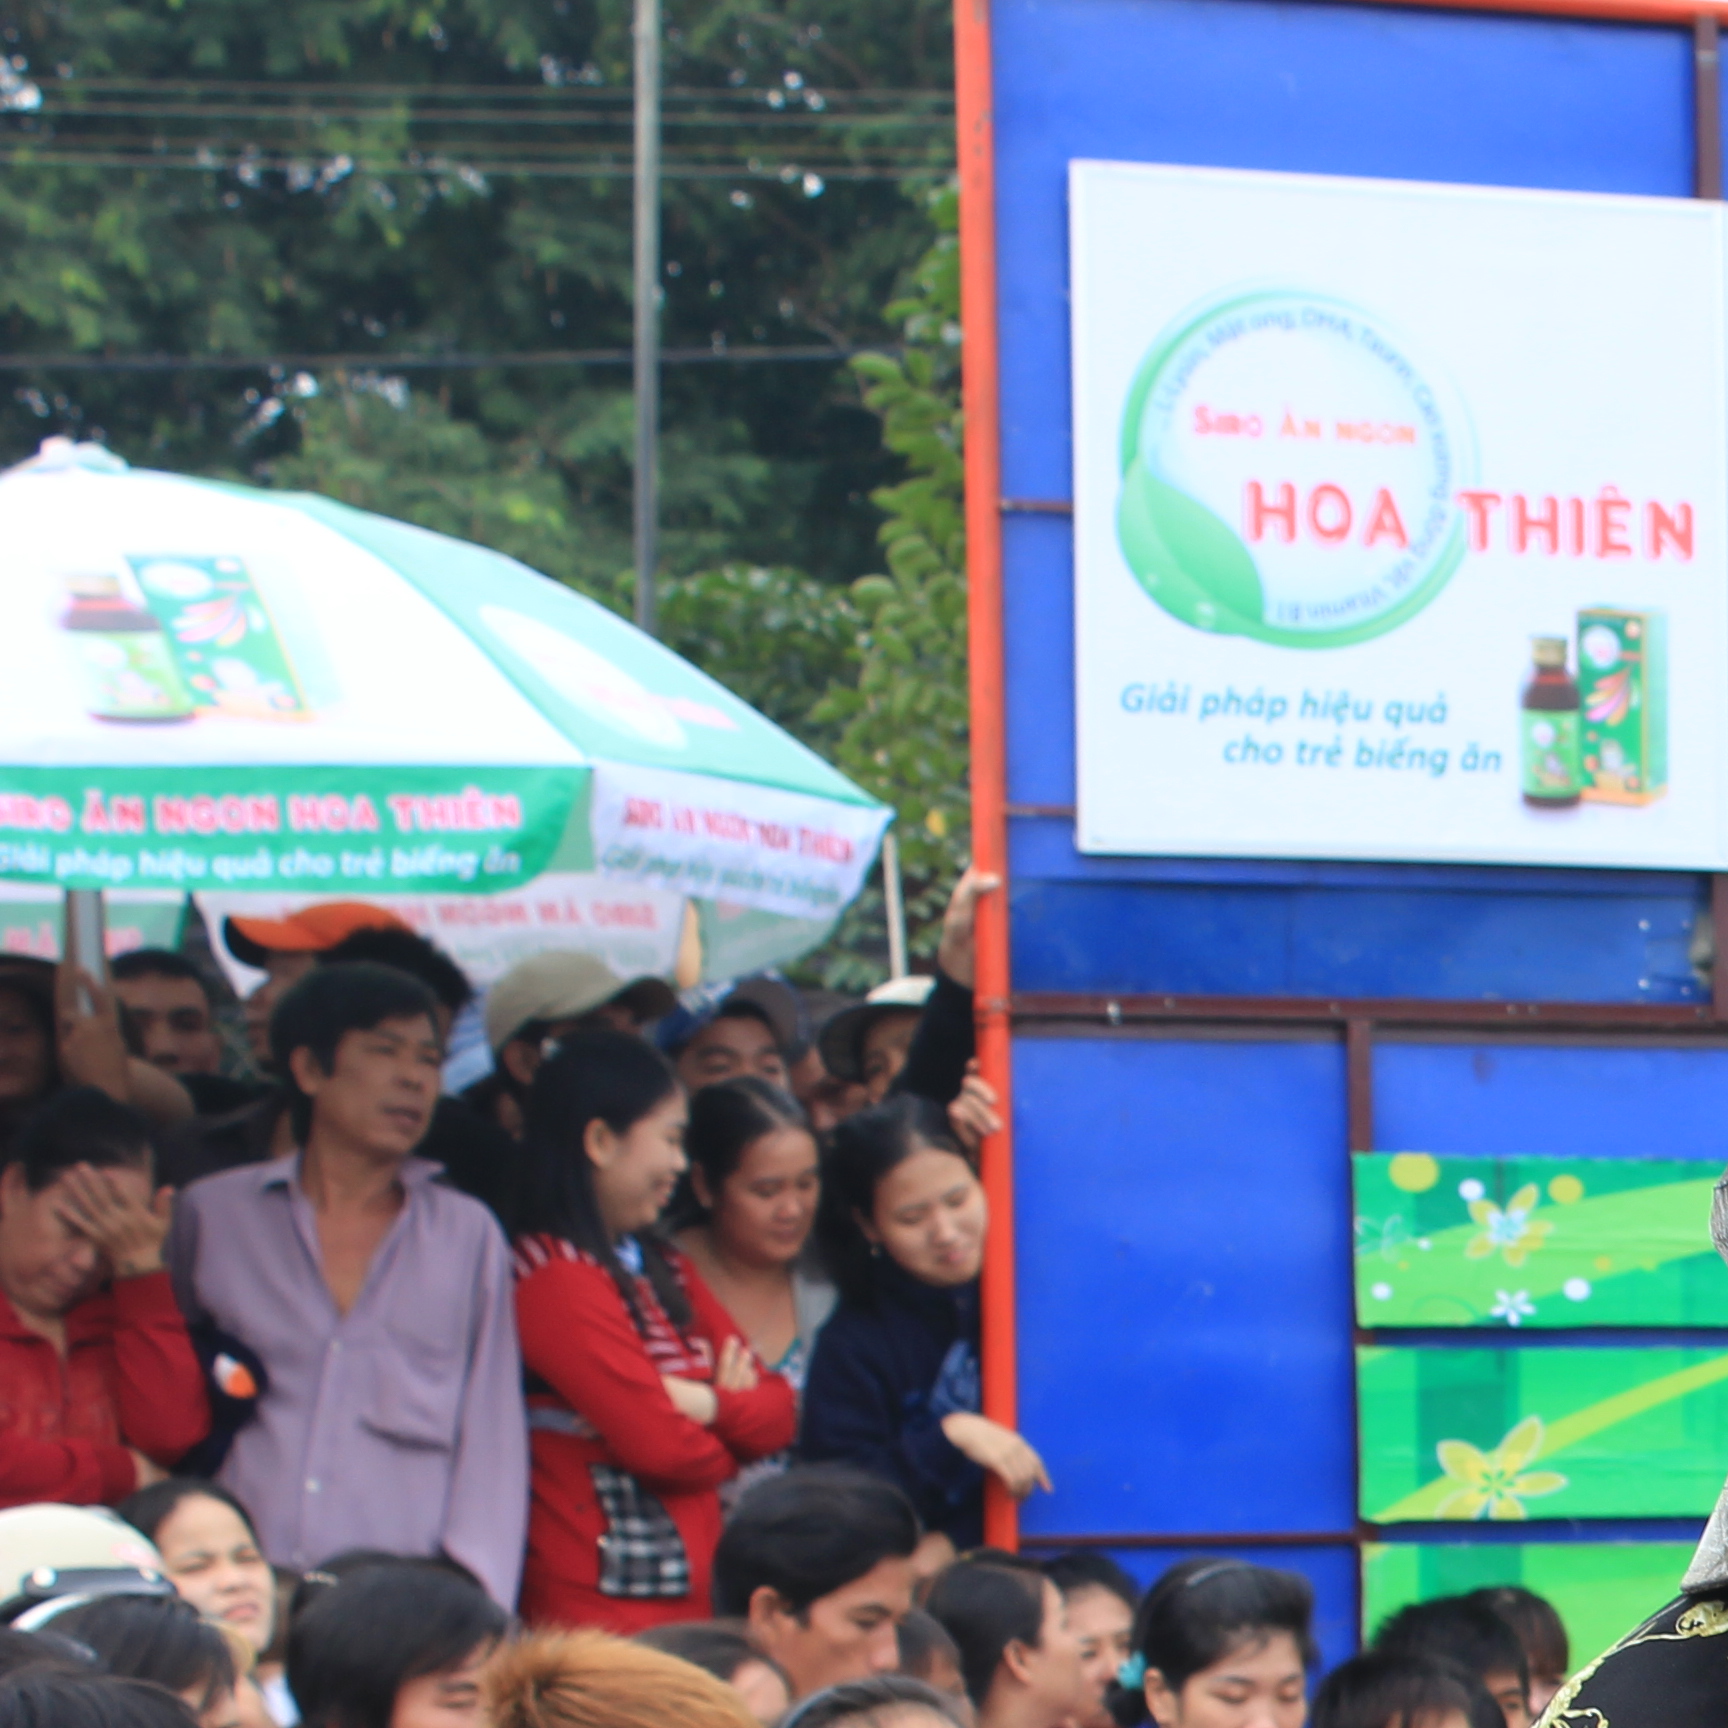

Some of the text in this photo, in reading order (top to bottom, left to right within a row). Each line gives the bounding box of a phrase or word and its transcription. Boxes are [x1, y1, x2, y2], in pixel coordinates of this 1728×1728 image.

[1247, 479, 1696, 562] HOA THIÊN
[1120, 683, 1449, 730] Giải pháp hiệu quả
[1223, 733, 1503, 777] cho trẻ biếng ăn
[153, 793, 281, 835] NGON
[287, 792, 382, 834] HOA
[388, 784, 523, 834] THIÊN
[278, 845, 337, 878] cho
